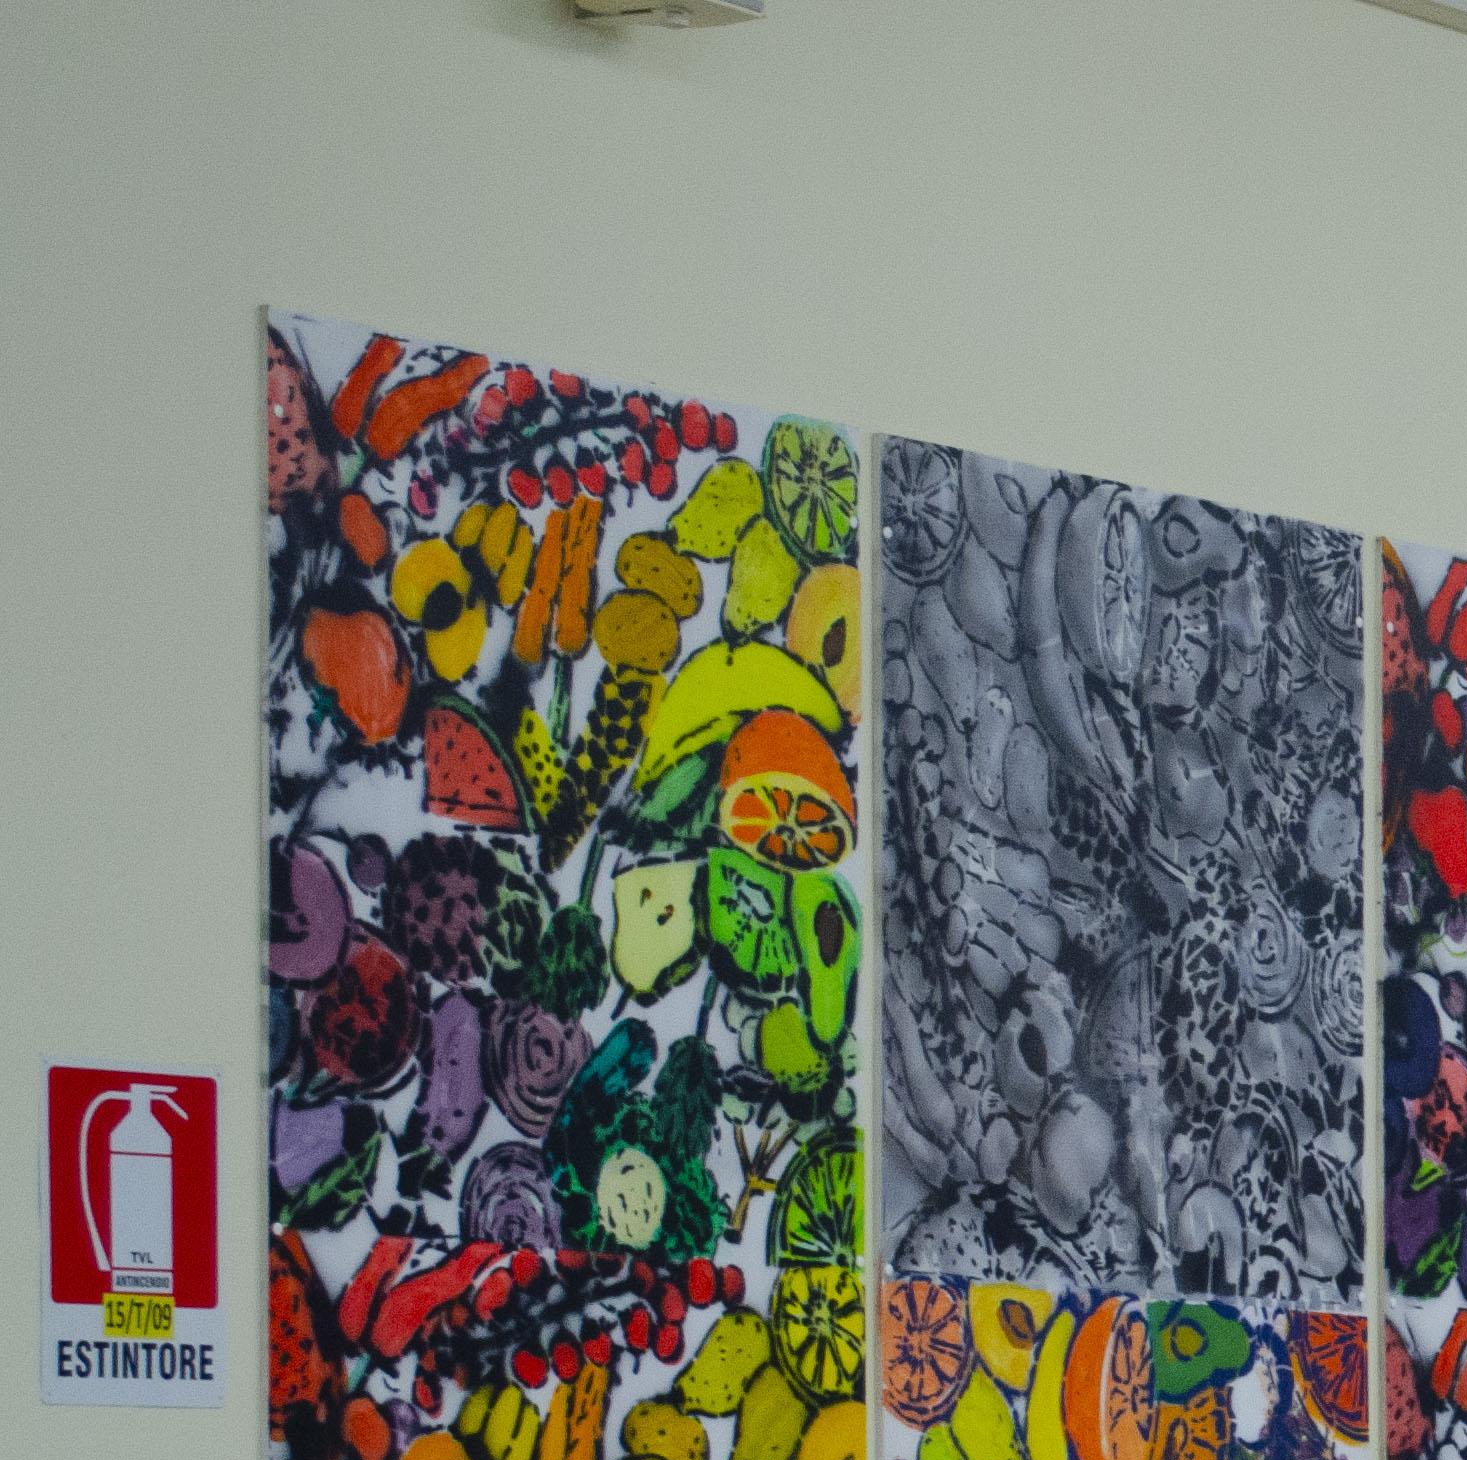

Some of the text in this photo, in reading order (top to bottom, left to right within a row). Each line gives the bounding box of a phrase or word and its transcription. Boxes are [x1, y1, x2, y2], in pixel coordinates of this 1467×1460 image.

[131, 1251, 153, 1264] TVL
[116, 1275, 170, 1289] ANTINCENDIO
[105, 1299, 172, 1334] 15/T/09
[57, 1340, 214, 1380] ESTINTORE
